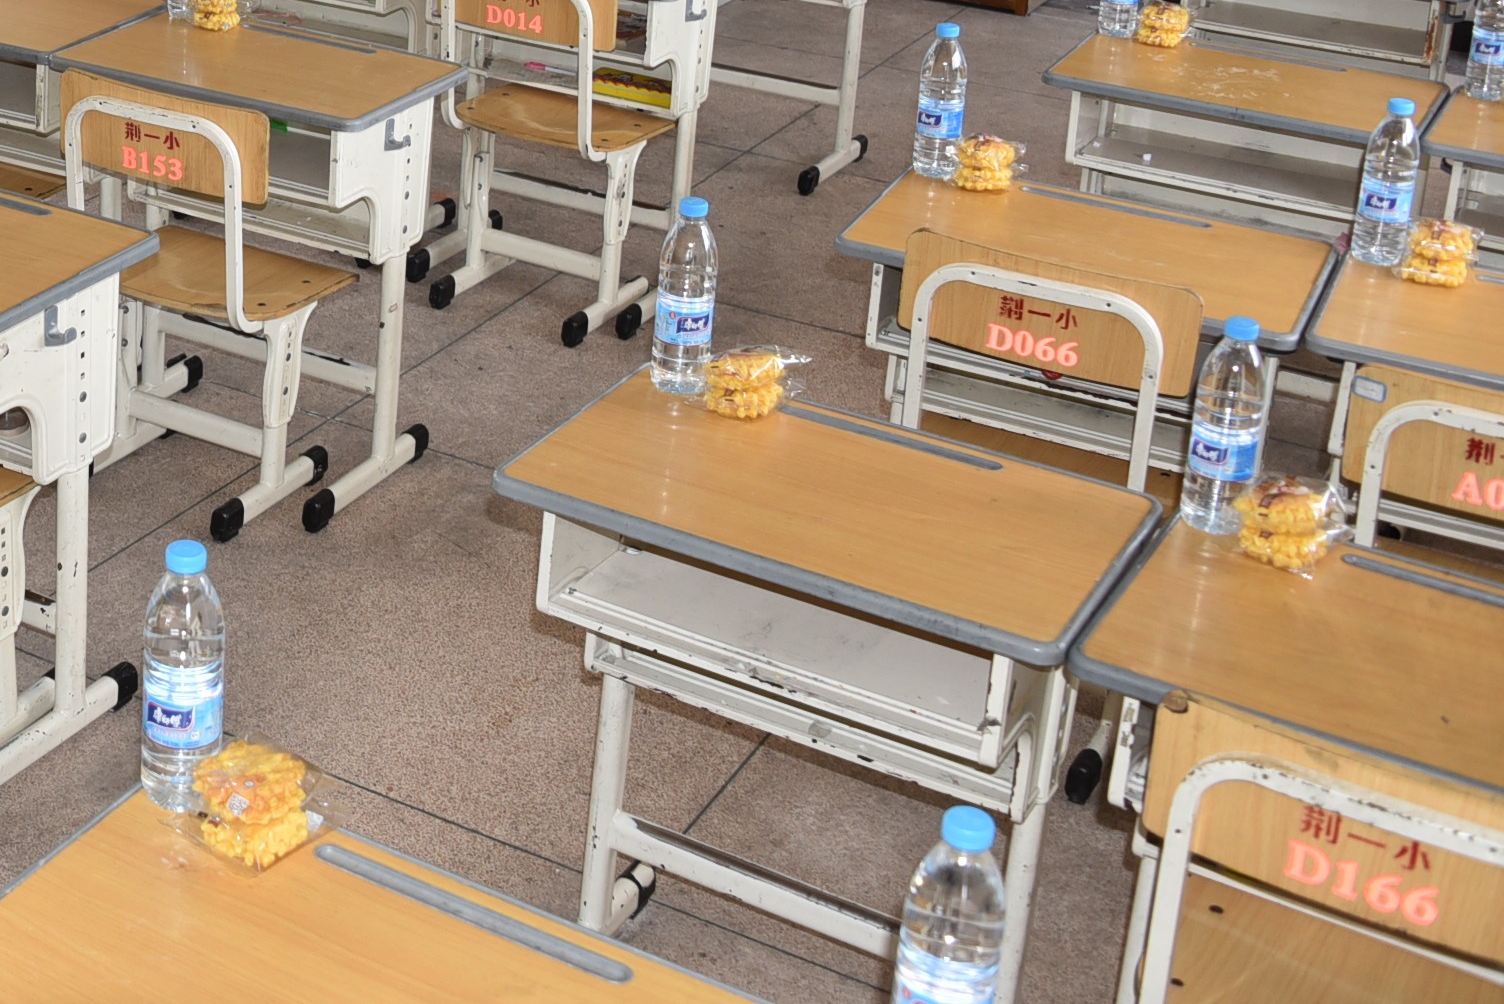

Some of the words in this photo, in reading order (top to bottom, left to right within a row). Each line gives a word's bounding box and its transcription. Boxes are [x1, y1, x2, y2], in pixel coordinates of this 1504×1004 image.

[486, 4, 543, 34] D014
[124, 121, 180, 150] 荆一小
[122, 146, 183, 181] B153
[999, 295, 1078, 330] 荆一小
[985, 323, 1079, 367] D066
[1300, 804, 1430, 870] 荆一小
[1283, 839, 1441, 927] D166
